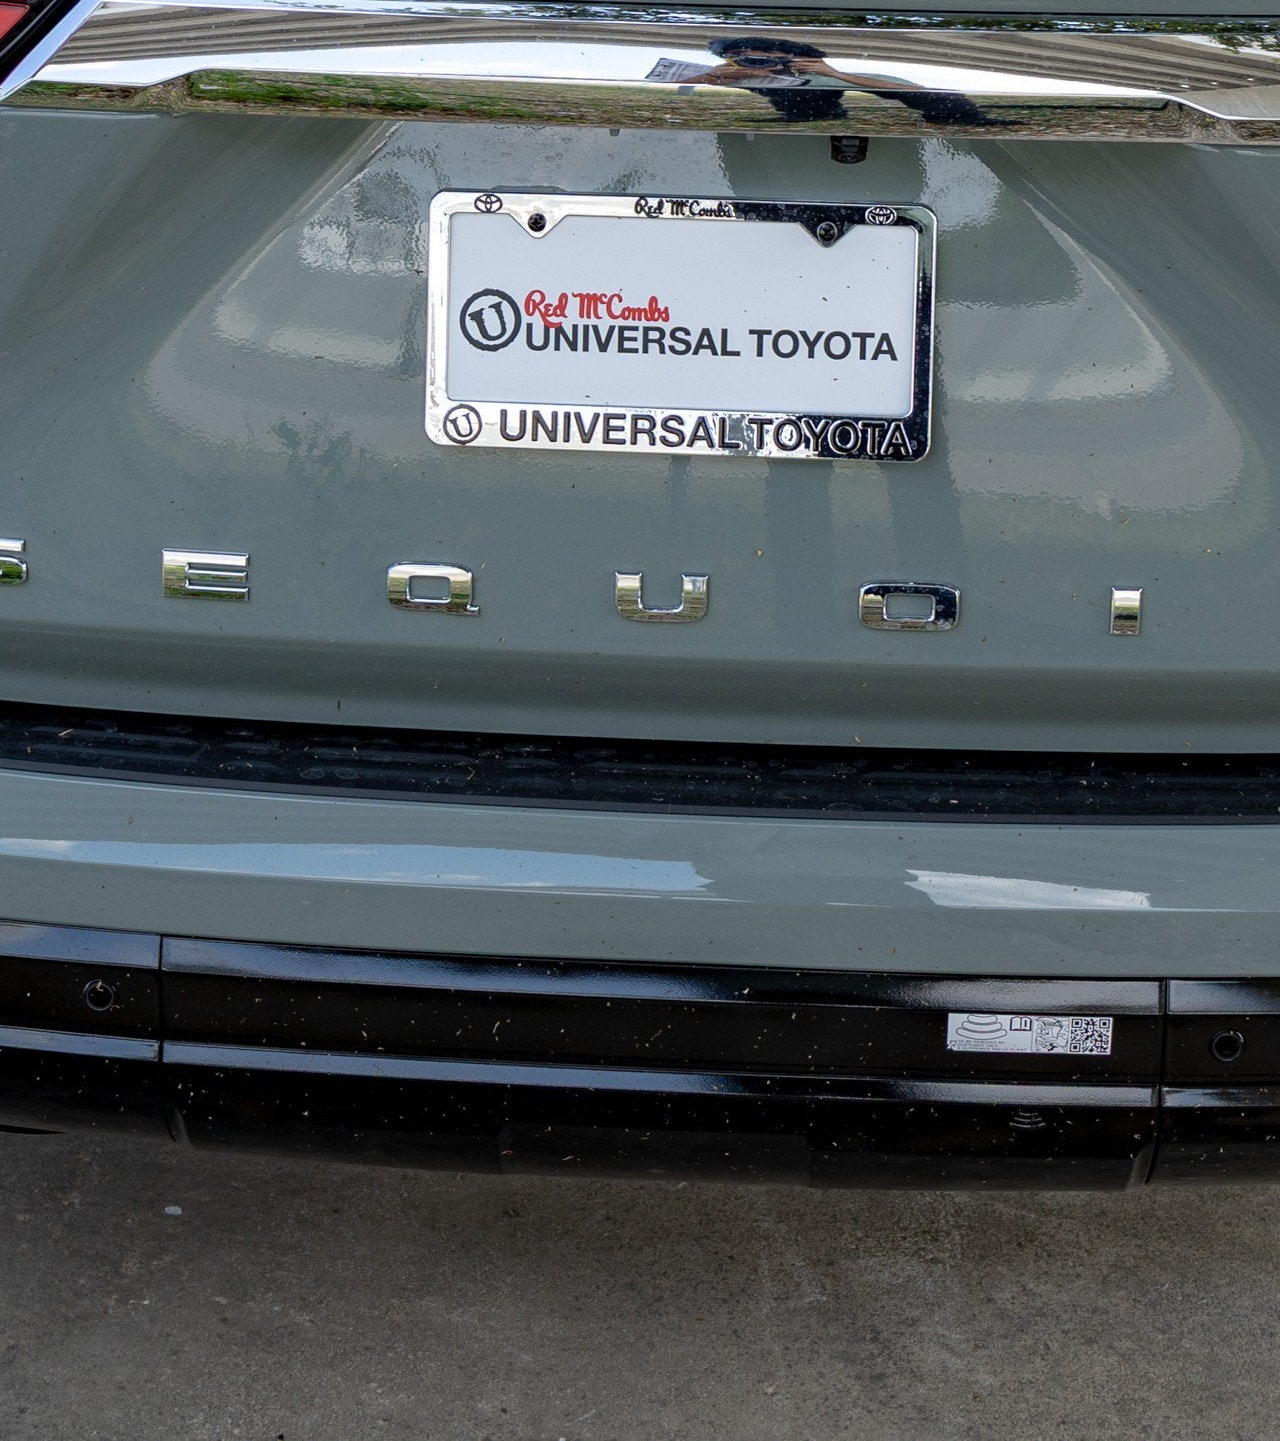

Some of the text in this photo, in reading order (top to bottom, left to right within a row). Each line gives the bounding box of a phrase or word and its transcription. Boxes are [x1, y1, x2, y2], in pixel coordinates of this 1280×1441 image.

[634, 197, 664, 218] Red
[524, 290, 670, 328] Red McCombs
[525, 323, 898, 361] UNIVERSAL TOYOTA
[500, 408, 913, 456] UNIVERSAL TOYOTA
